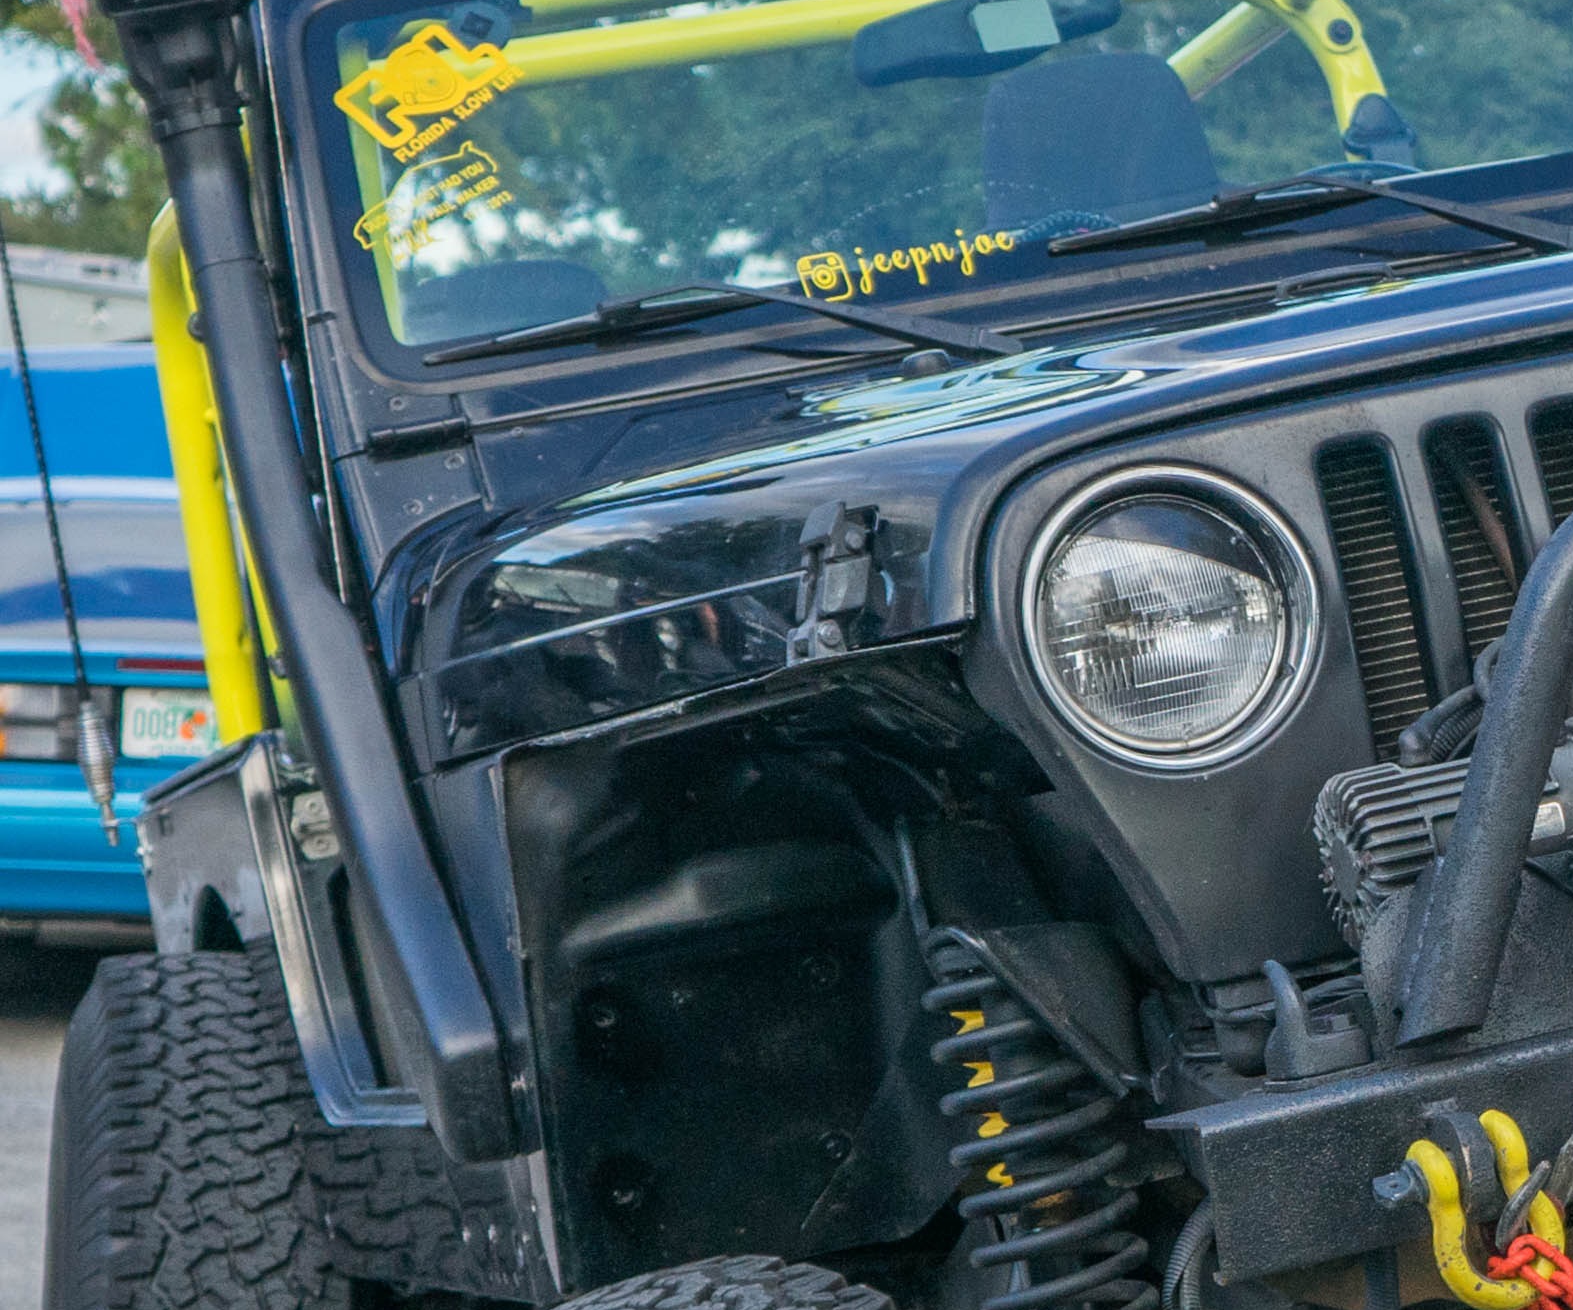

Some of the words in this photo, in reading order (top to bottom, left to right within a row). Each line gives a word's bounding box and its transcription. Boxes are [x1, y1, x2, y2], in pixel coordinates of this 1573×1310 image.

[393, 117, 457, 163] FLORIDA
[453, 87, 494, 120] SLOW
[458, 161, 486, 180] YOU
[854, 228, 1015, 295] jeepnjoe
